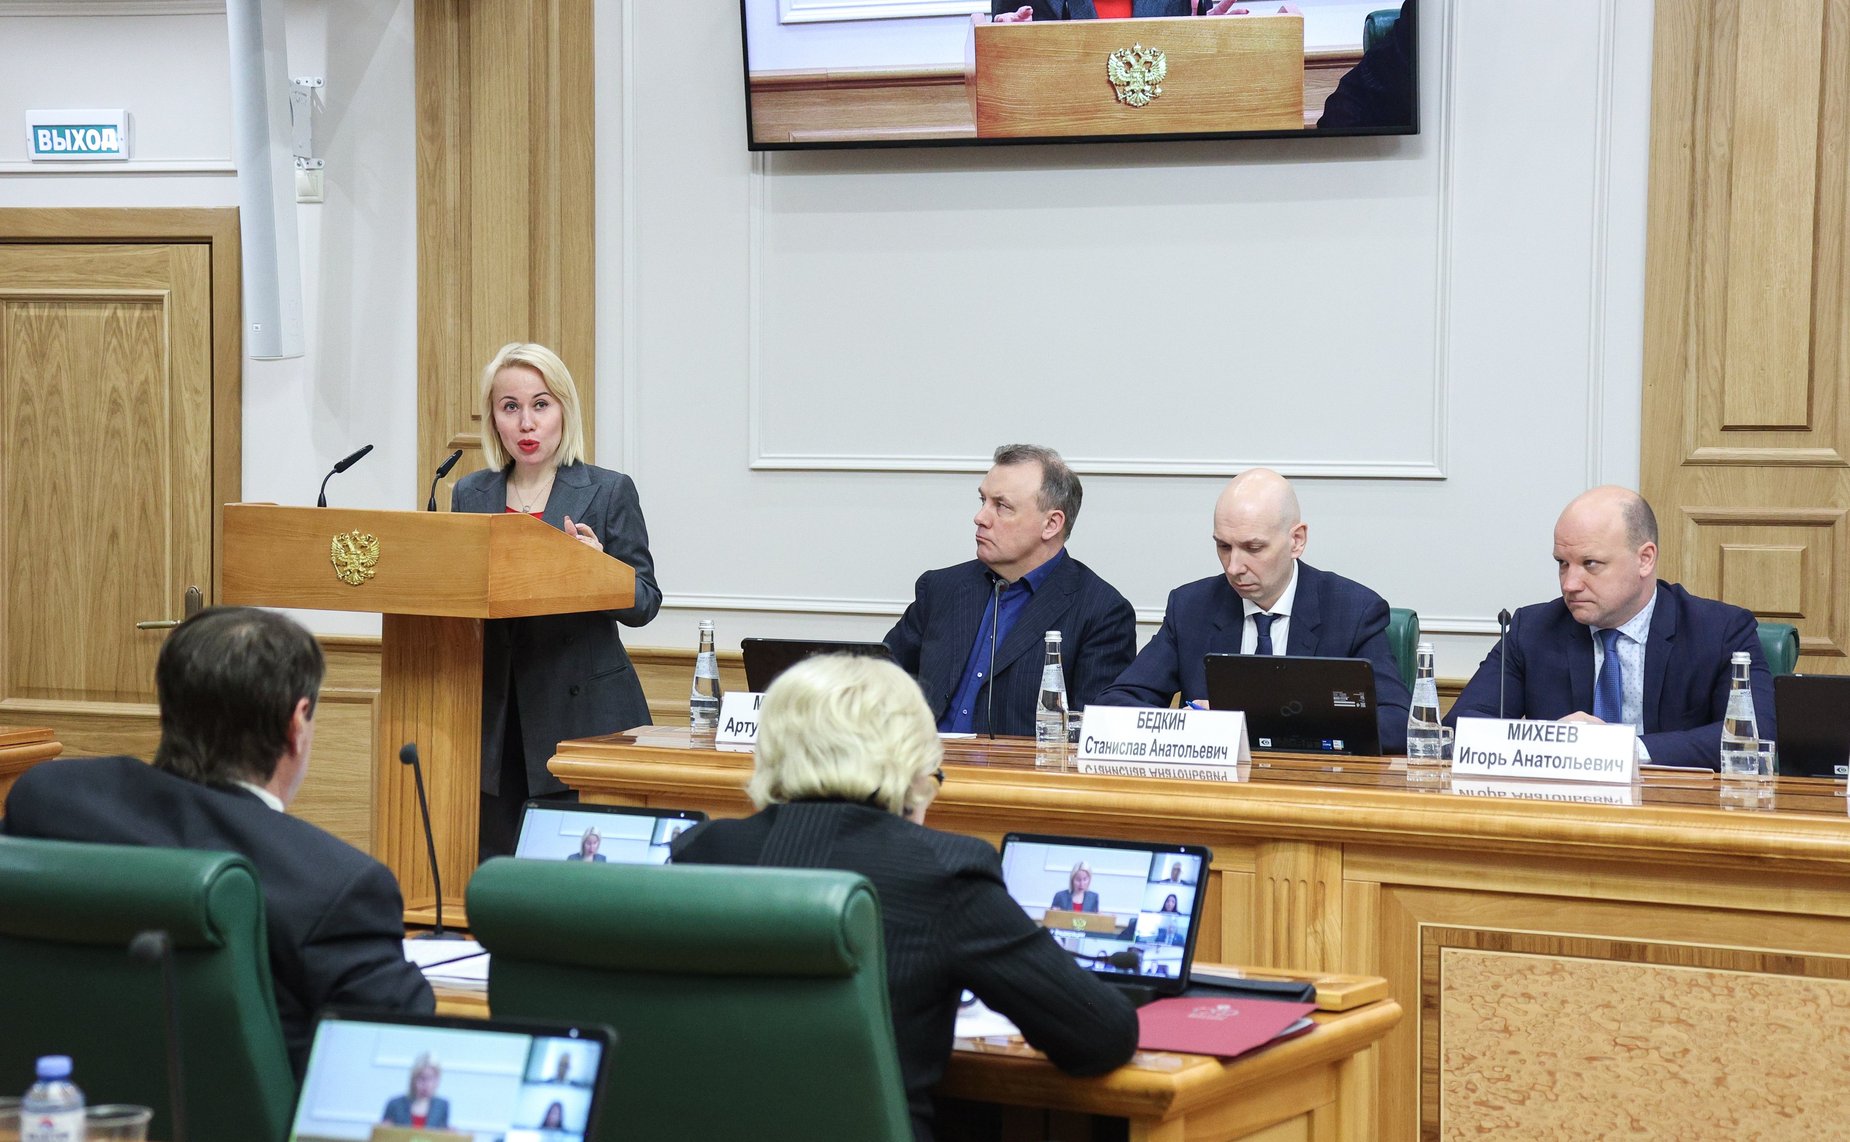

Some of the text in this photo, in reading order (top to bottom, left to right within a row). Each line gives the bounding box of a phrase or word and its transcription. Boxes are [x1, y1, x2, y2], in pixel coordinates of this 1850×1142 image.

[37, 129, 118, 151] ВЫХОД
[724, 716, 759, 737] Арту
[1137, 711, 1186, 733] БЕДКИН
[1507, 723, 1578, 743] МИХЕЕВ
[1085, 735, 1228, 760] Станислав Анатольевич
[1459, 746, 1624, 772] Игорь Анатольевич
